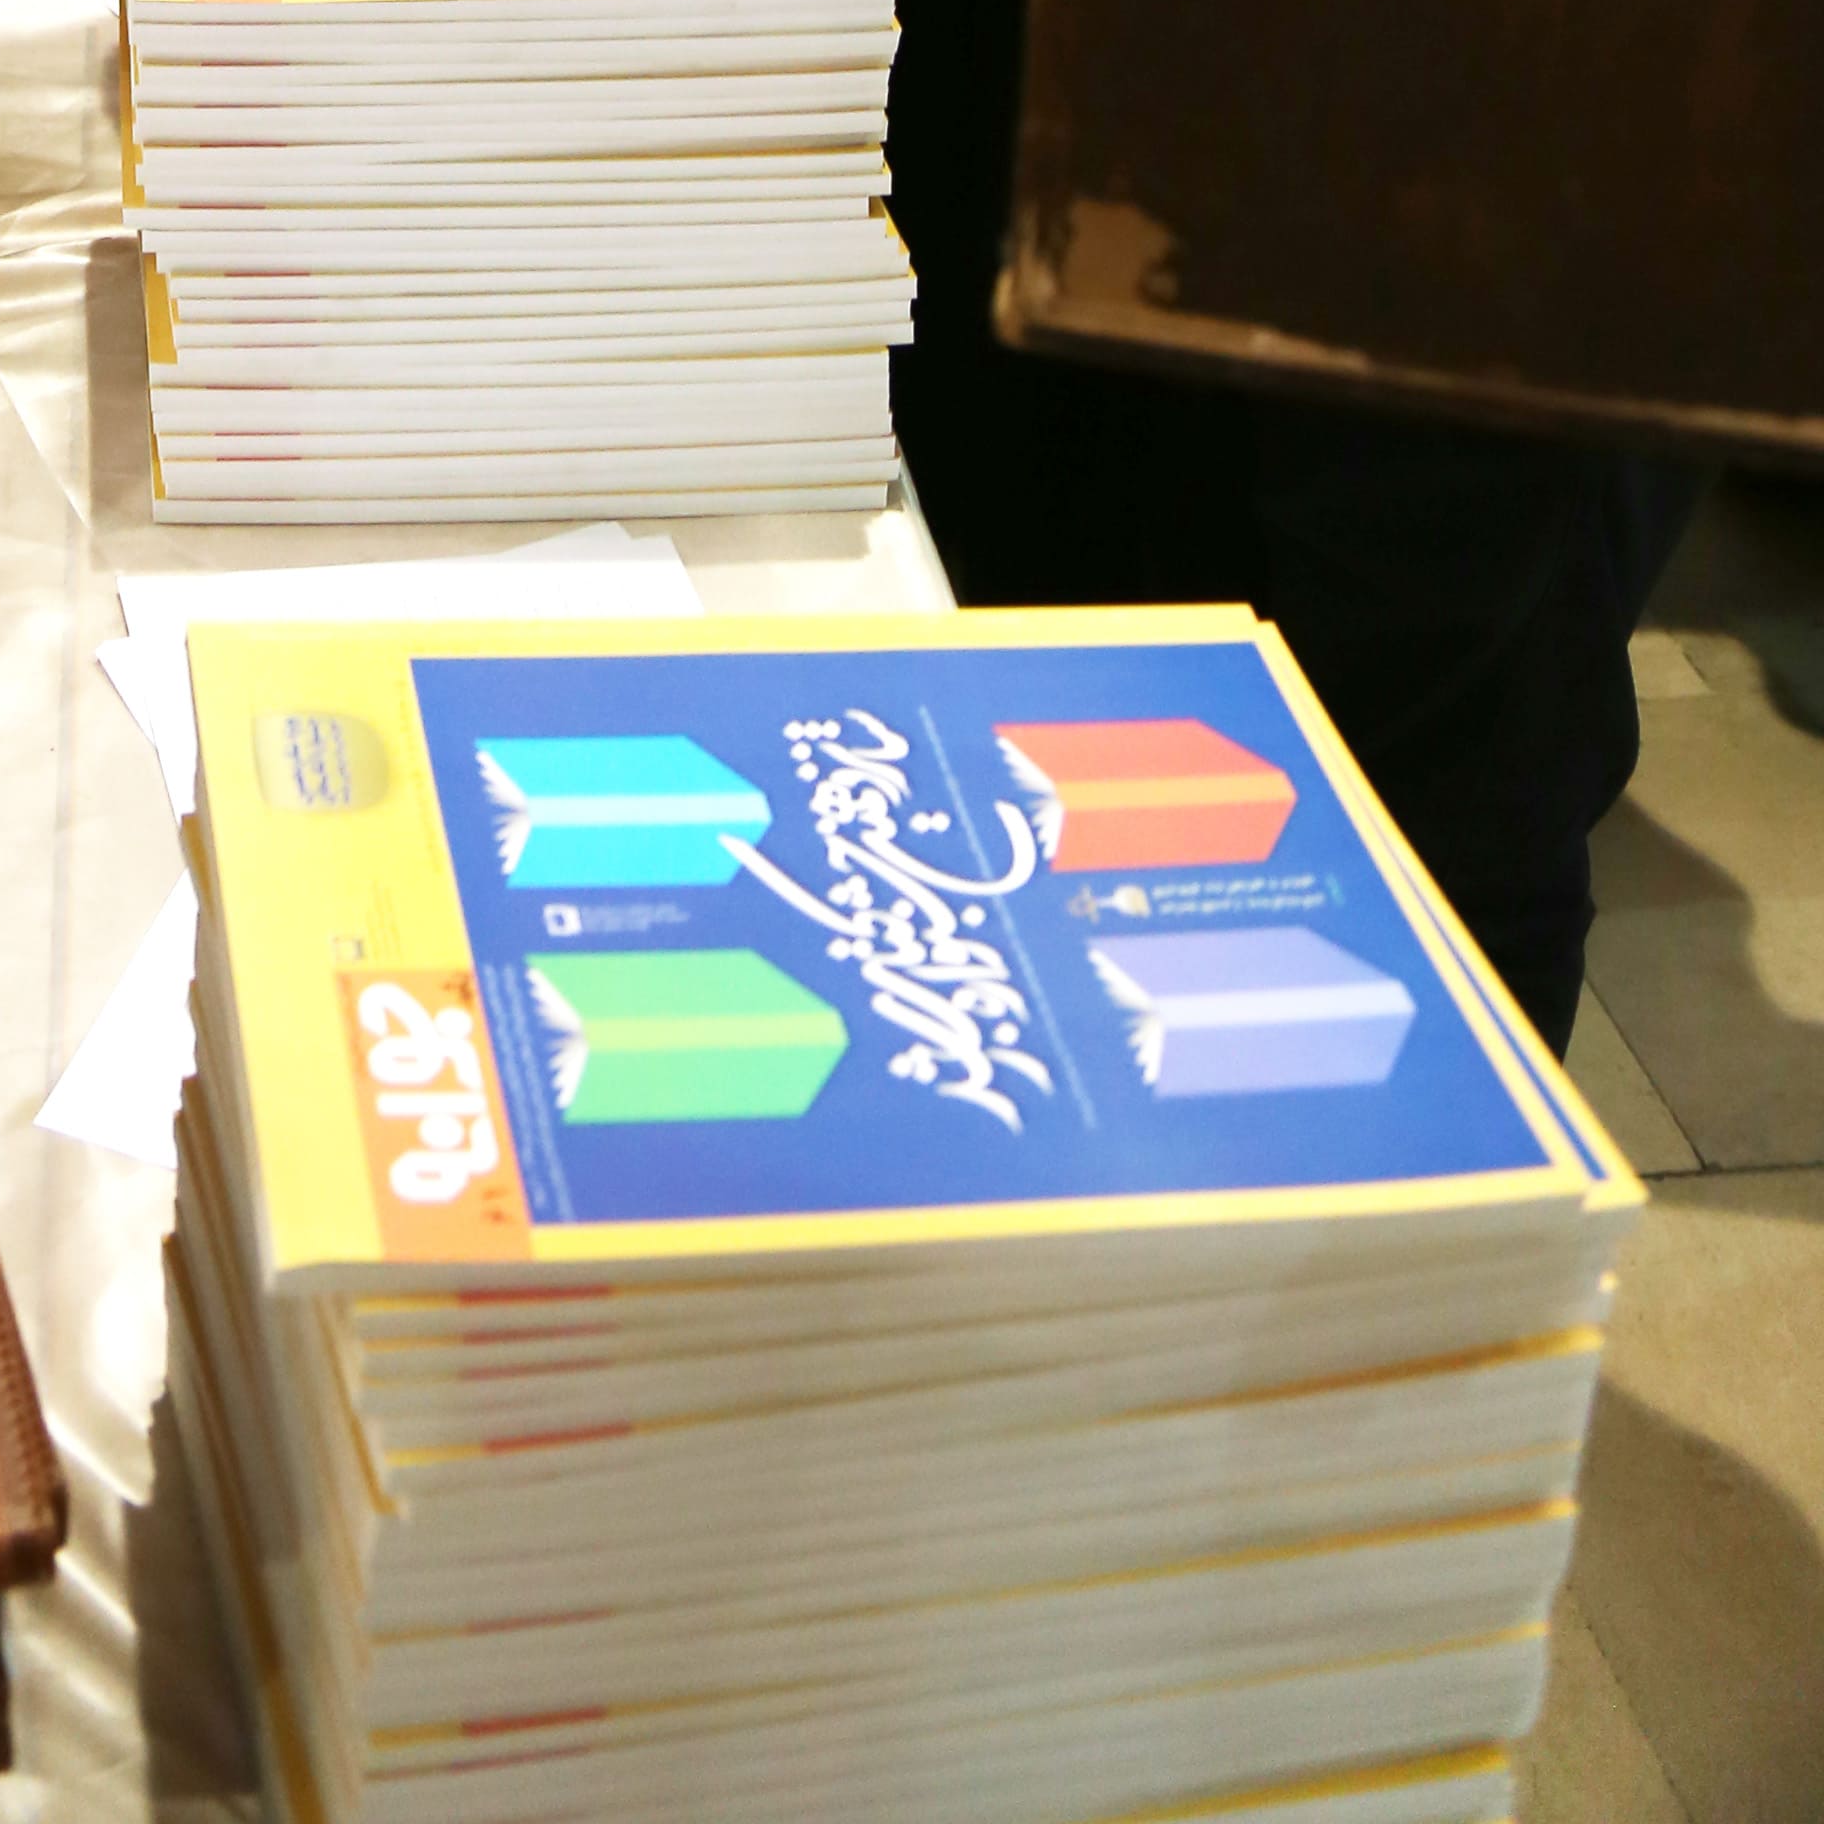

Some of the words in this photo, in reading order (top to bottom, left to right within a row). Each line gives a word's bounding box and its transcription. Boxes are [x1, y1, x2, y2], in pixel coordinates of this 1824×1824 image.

[783, 708, 1037, 896] شانزدهمین
[824, 834, 1030, 1024] جشنواره
[358, 981, 499, 1203] جوانه
